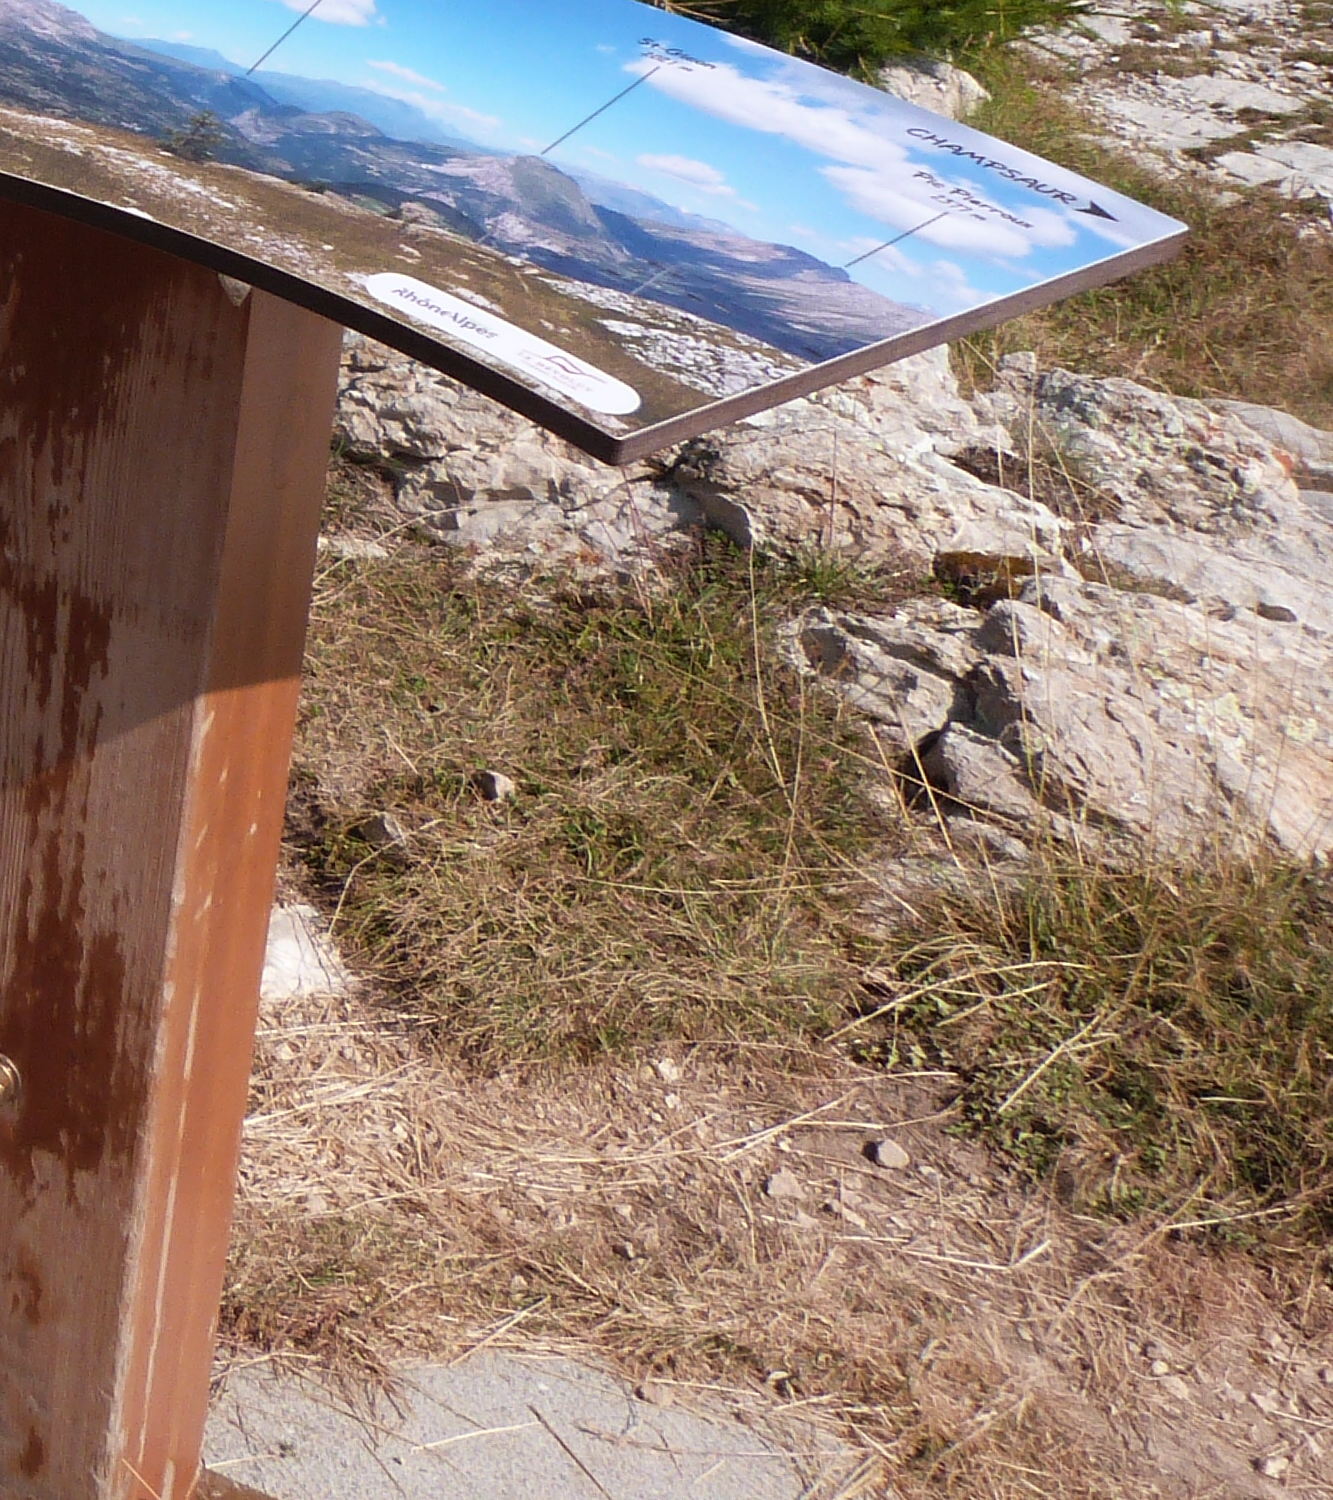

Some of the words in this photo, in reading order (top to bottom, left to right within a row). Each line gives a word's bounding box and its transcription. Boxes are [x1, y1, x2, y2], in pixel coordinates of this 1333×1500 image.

[906, 127, 1078, 205] CHAMPSAUR
[913, 171, 945, 188] Pic
[949, 187, 1035, 228] Pierroux
